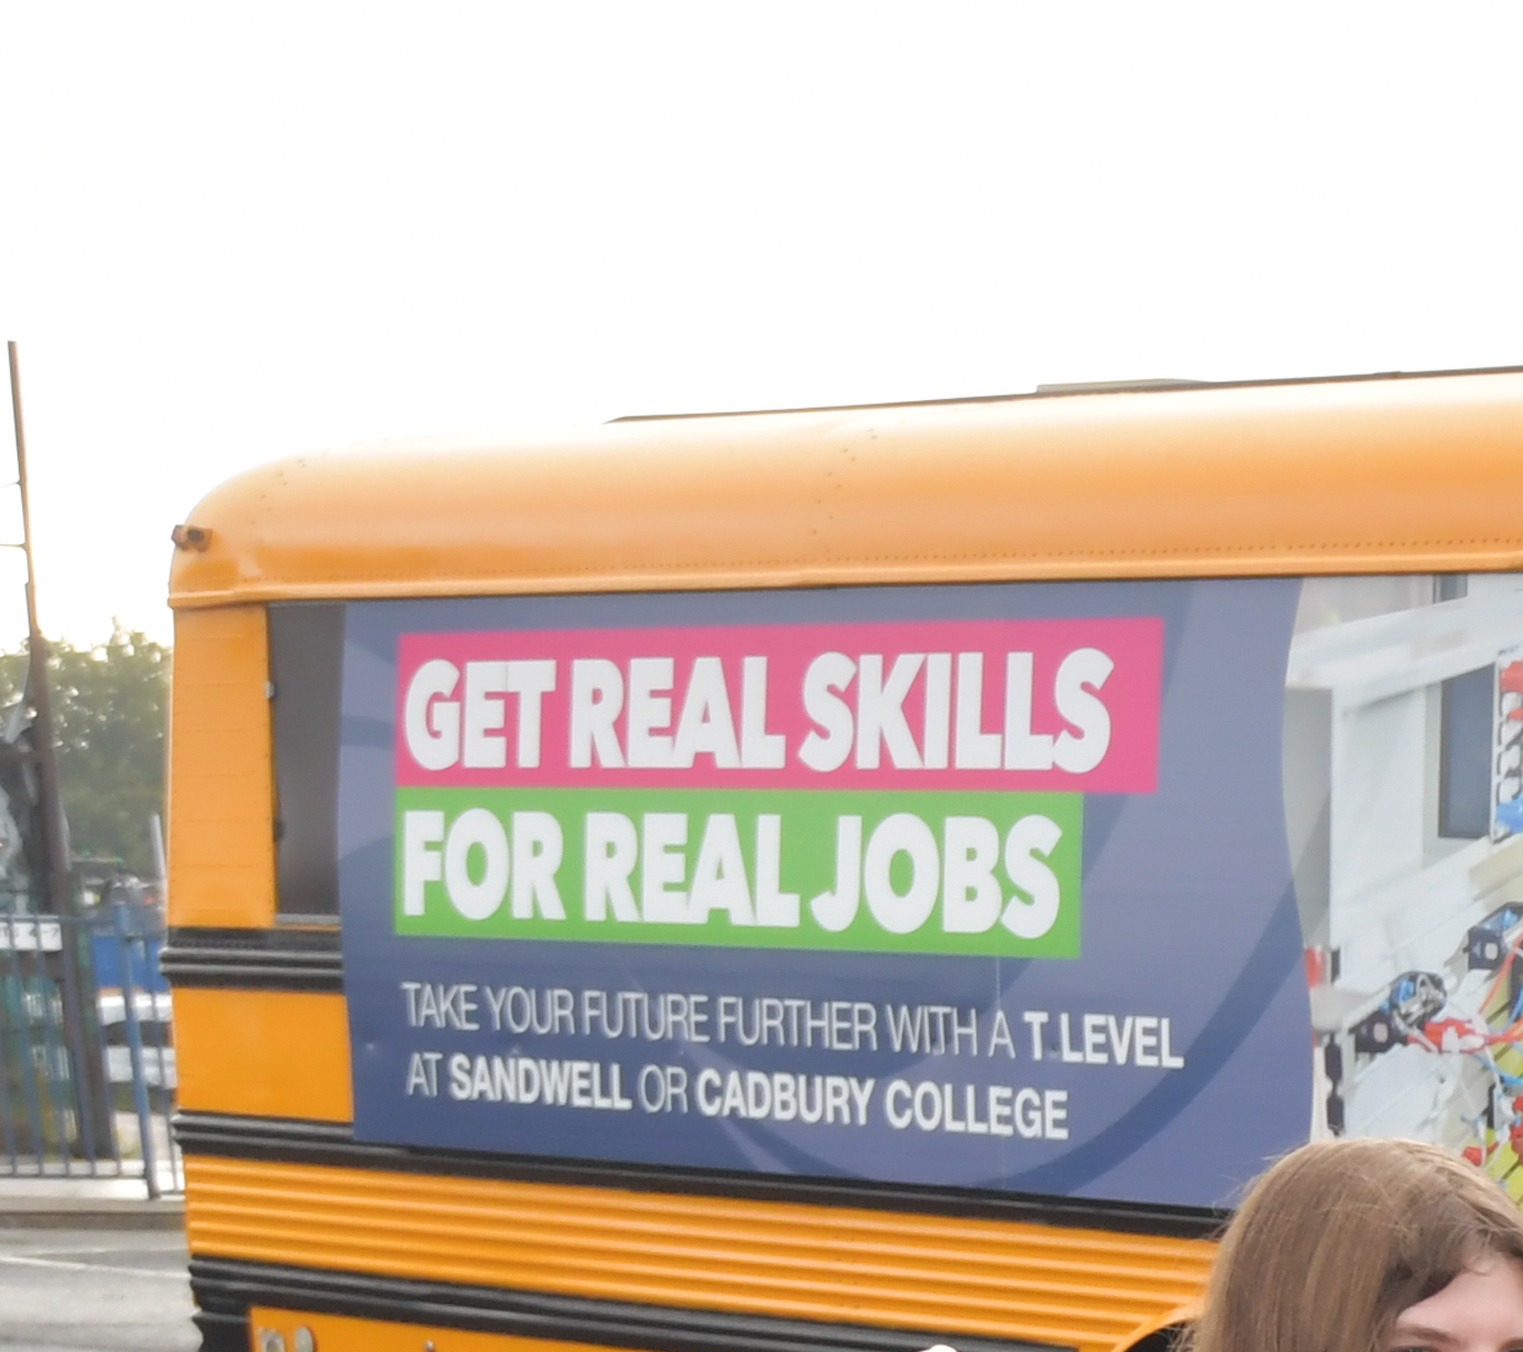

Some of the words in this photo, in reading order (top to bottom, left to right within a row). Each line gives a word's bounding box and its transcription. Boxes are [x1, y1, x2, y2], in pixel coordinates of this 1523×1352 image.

[402, 659, 556, 771] GET
[569, 656, 786, 770] REAL
[798, 648, 1115, 774] SKILLS
[402, 808, 566, 922] FOR
[584, 812, 799, 928] REAL
[810, 812, 1063, 940] JOBS
[402, 982, 478, 1029] TAKE
[485, 986, 576, 1036] YOUR
[581, 989, 710, 1043] FUTURE
[719, 996, 878, 1053] FURTHER
[886, 1005, 978, 1056] WITH
[989, 1009, 1016, 1057] A
[1023, 1012, 1049, 1058] T
[1059, 1013, 1184, 1068] LEVEL
[406, 1052, 443, 1096] AT
[449, 1054, 632, 1111] SANDWELL
[639, 1063, 689, 1113] OR
[697, 1067, 876, 1128] CADBURY
[885, 1081, 1069, 1140] COLLEGE
